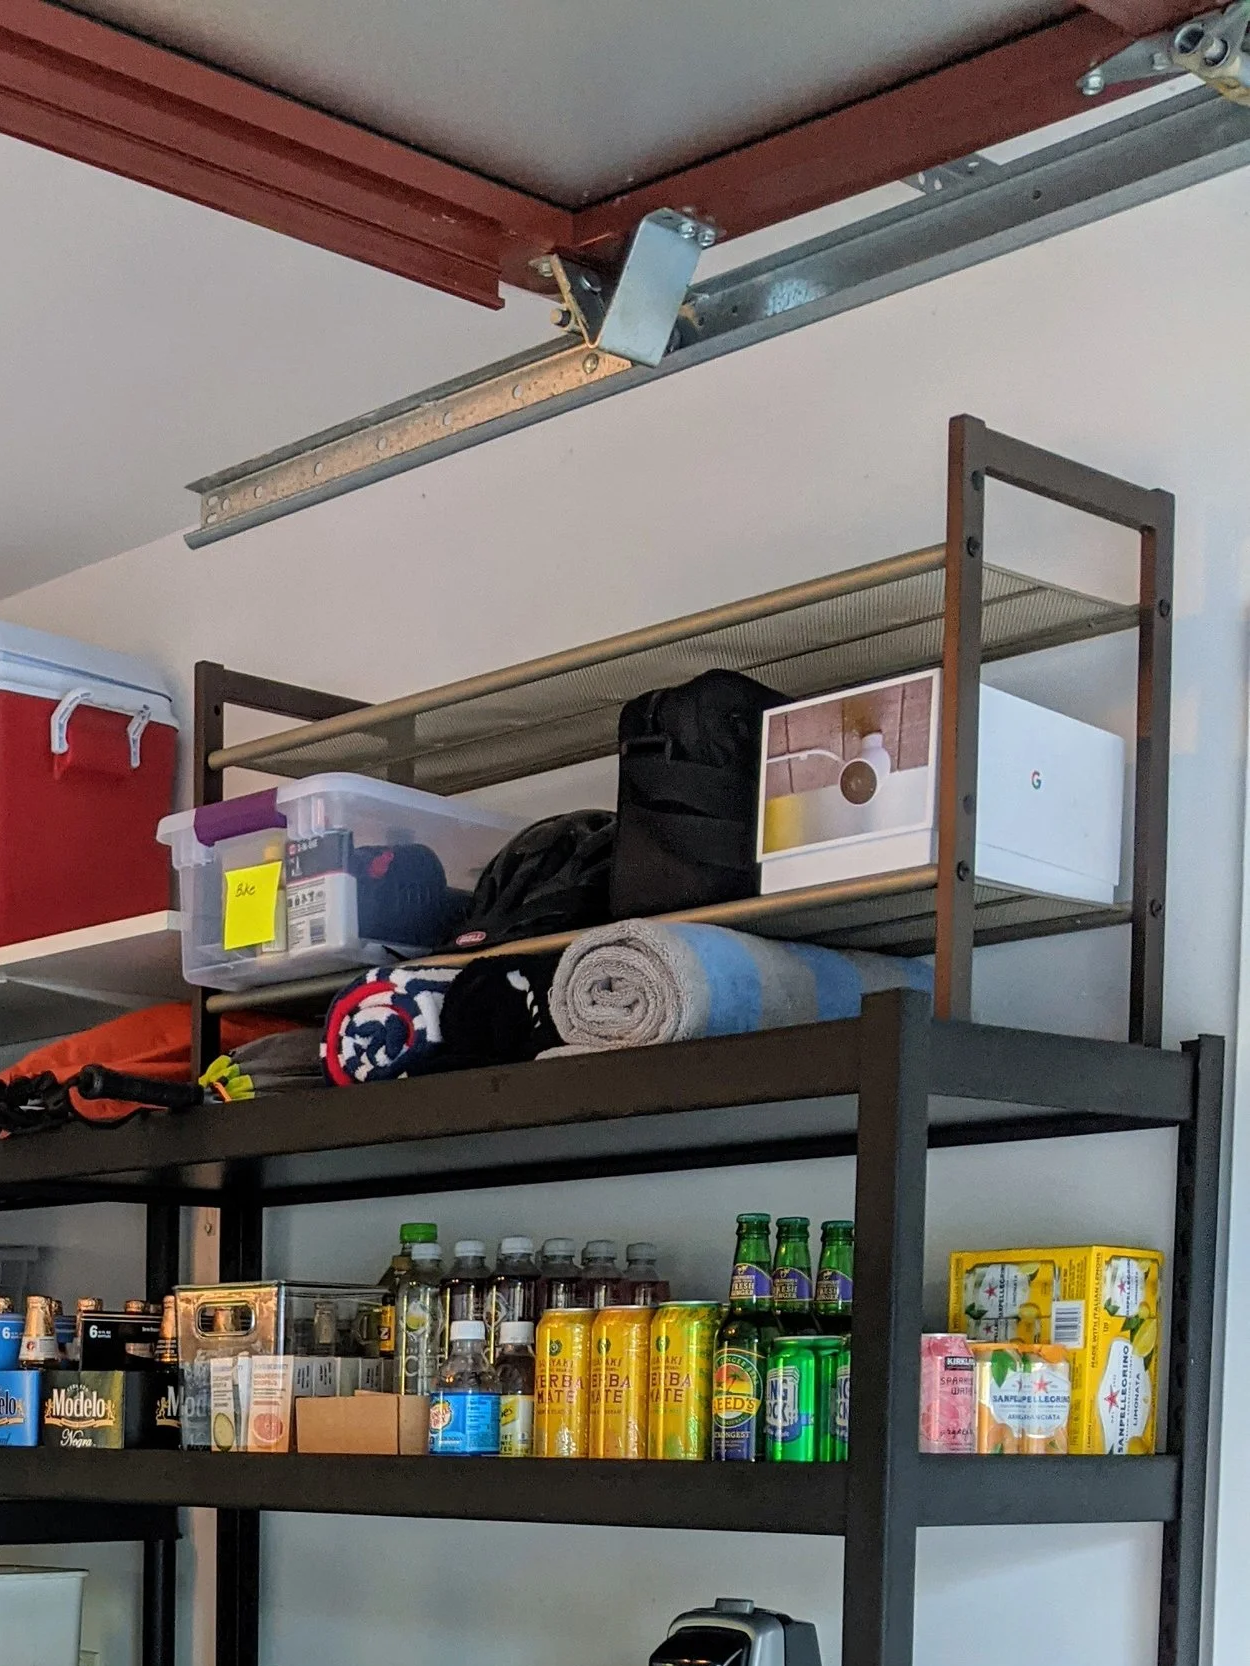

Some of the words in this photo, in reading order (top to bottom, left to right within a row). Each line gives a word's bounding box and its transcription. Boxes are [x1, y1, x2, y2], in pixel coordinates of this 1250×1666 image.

[1031, 770, 1042, 790] G
[1094, 1252, 1102, 1286] LEMONS
[2, 1326, 11, 1339] 6
[89, 1324, 98, 1339] 6
[52, 1387, 107, 1418] Modelo
[537, 1390, 576, 1404] MATE
[1117, 1345, 1130, 1453] SANPELLEGRINO
[1133, 1373, 1141, 1427] LIMONATA
[60, 1428, 94, 1447] Negra
